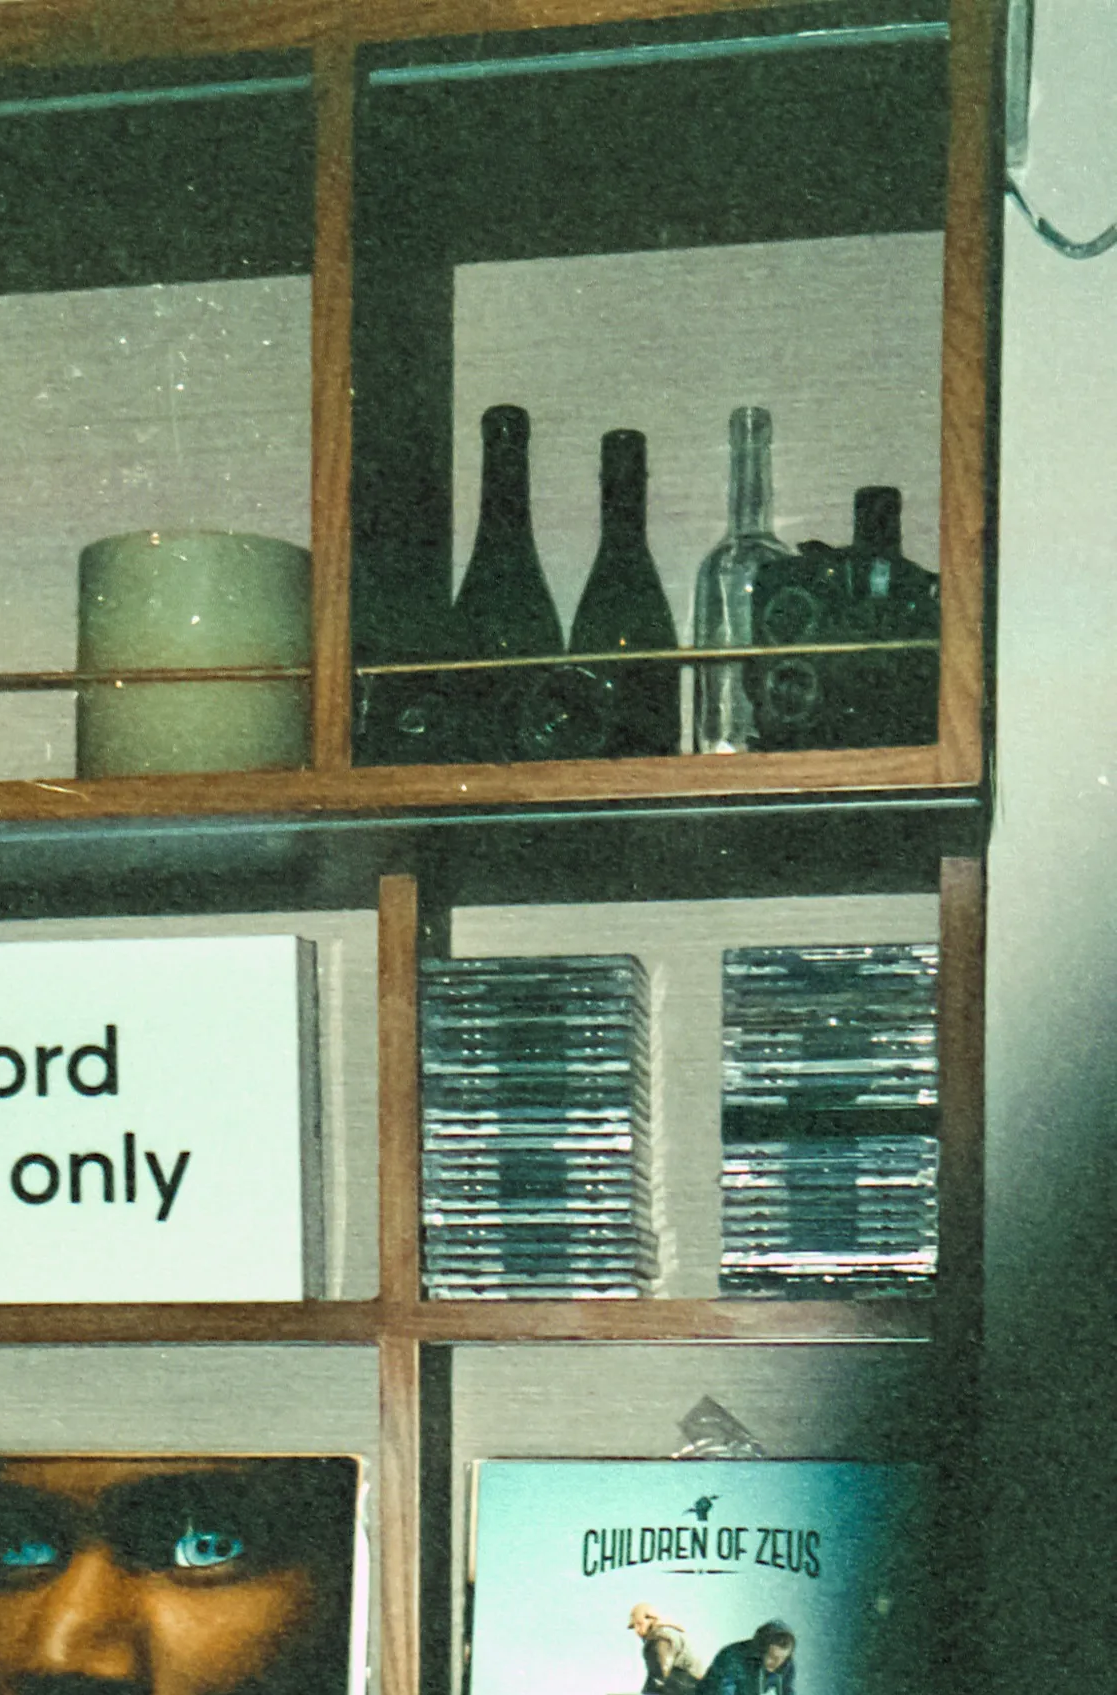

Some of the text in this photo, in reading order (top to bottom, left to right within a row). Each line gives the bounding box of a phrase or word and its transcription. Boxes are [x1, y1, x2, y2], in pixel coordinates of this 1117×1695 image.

[10, 1131, 191, 1222] only
[583, 1527, 821, 1579] CHILDREN OF ZEUS
